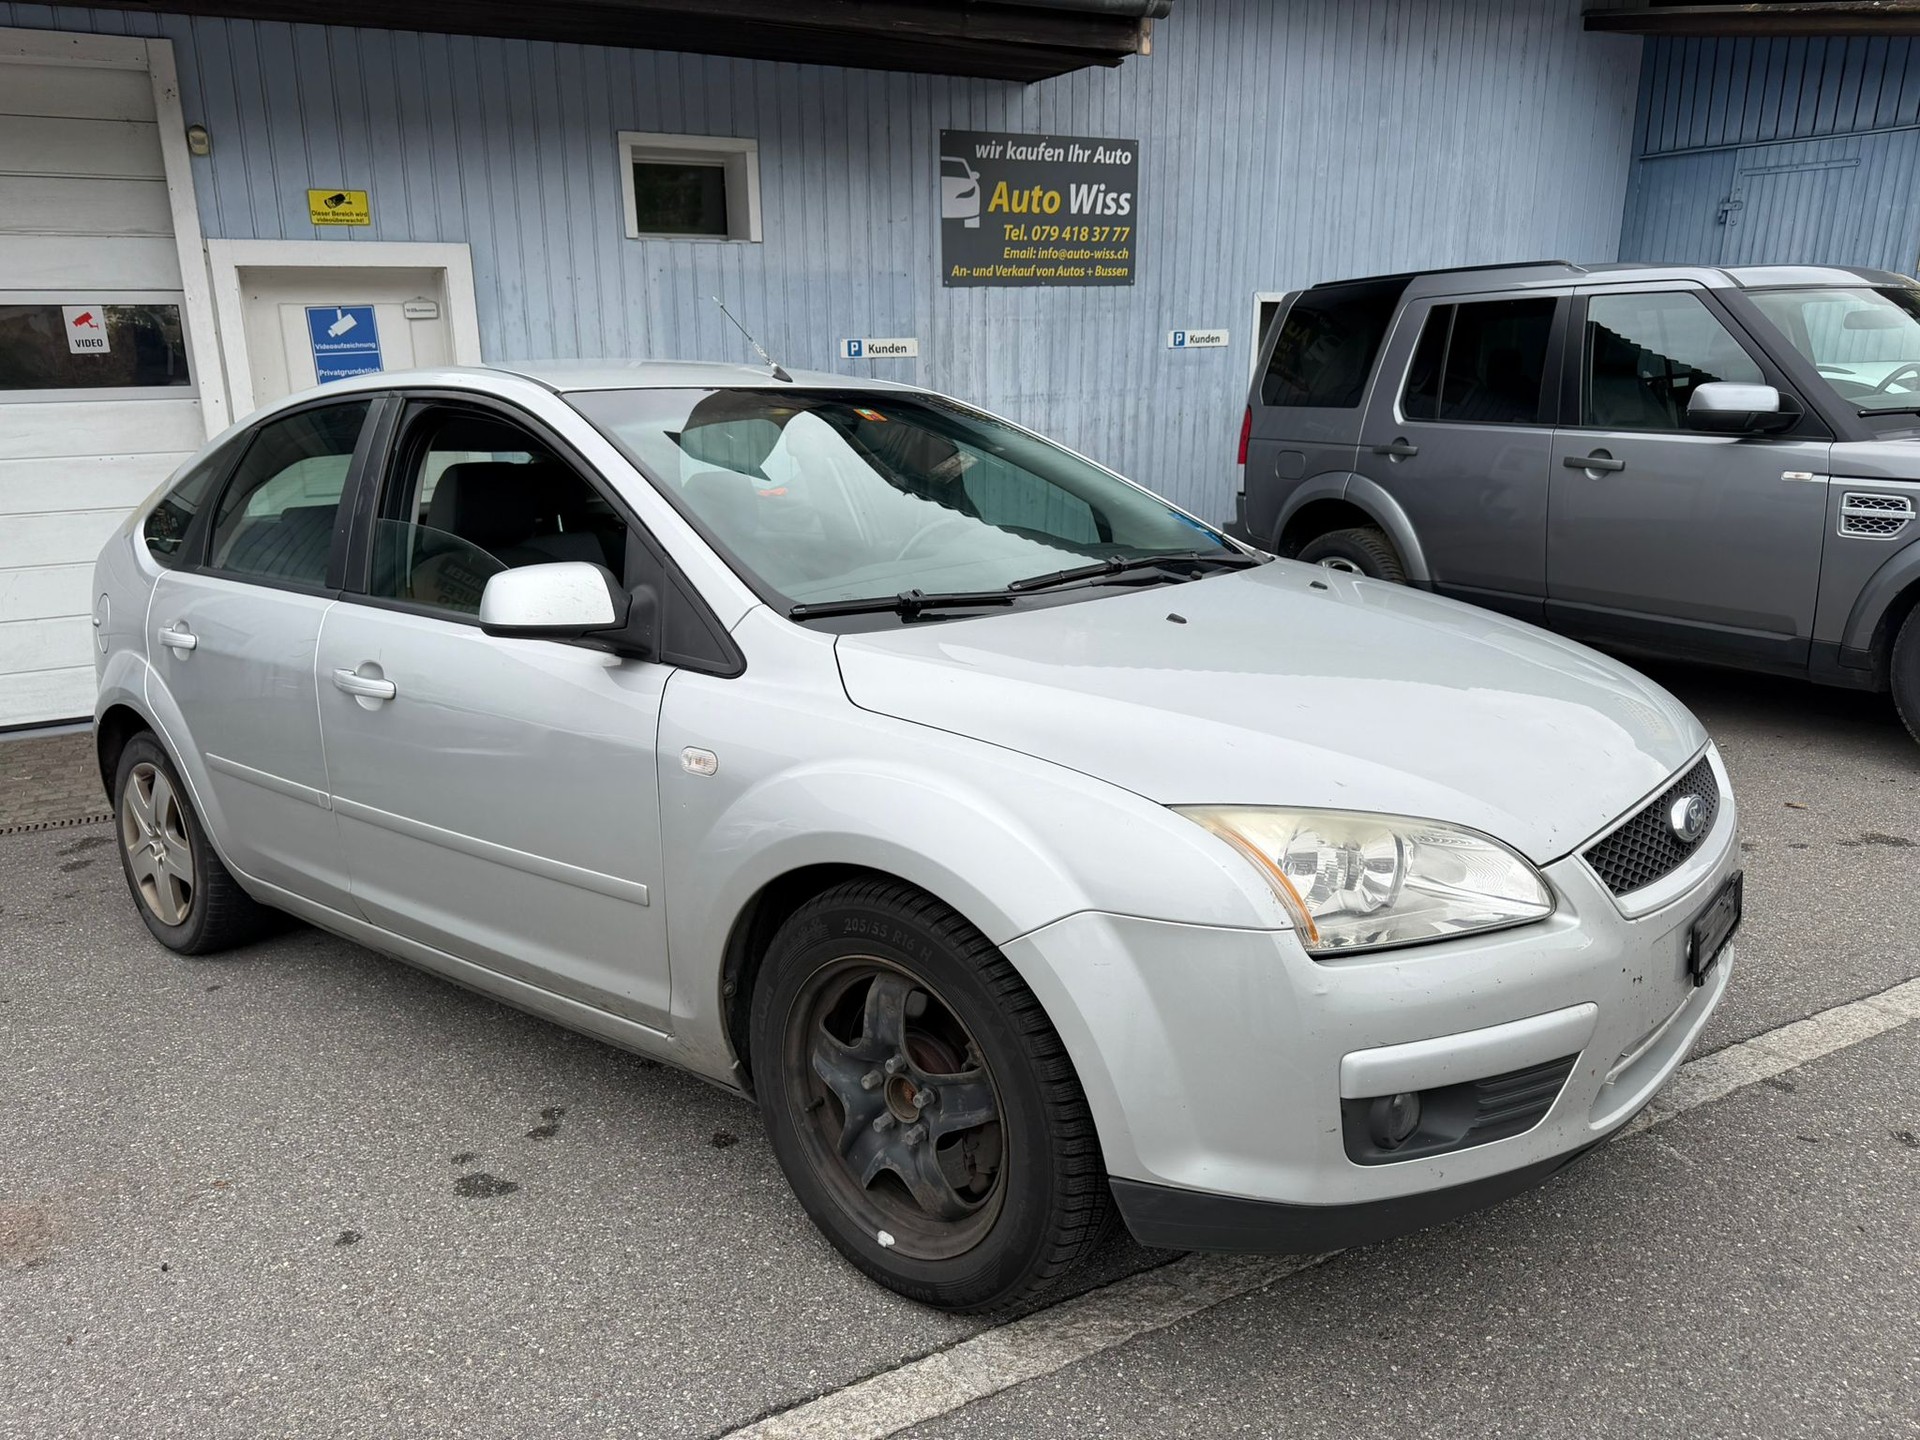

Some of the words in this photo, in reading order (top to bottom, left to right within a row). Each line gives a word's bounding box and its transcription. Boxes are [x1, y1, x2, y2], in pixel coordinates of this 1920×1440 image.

[975, 140, 1003, 159] wir
[1006, 140, 1064, 163] kaufen
[1067, 144, 1092, 163] Ihr
[1092, 145, 1132, 165] Auto
[987, 180, 1061, 214] Auto
[1069, 182, 1132, 216] Wiss
[311, 209, 331, 217] Dieser
[1003, 224, 1028, 241] Tel.
[1031, 225, 1060, 242] 079
[1061, 226, 1089, 242] 418
[1091, 226, 1110, 242] 37
[1111, 227, 1131, 242] 77
[1003, 247, 1036, 260] Email:
[1037, 247, 1130, 261] info@auto-wiss.ch
[951, 264, 971, 277] An-
[972, 264, 993, 277] und
[995, 264, 1036, 277] Verkauf
[1036, 267, 1055, 277] von
[1056, 264, 1085, 277] Autos
[1086, 268, 1093, 276] +
[1095, 265, 1128, 277] Bussen
[74, 338, 104, 348] VIDEO
[1189, 334, 1220, 344] Kunden
[315, 342, 377, 350] Videoaufzeichnung
[868, 343, 908, 354] Kunden
[843, 917, 889, 938] 205/55
[892, 929, 916, 951] R16
